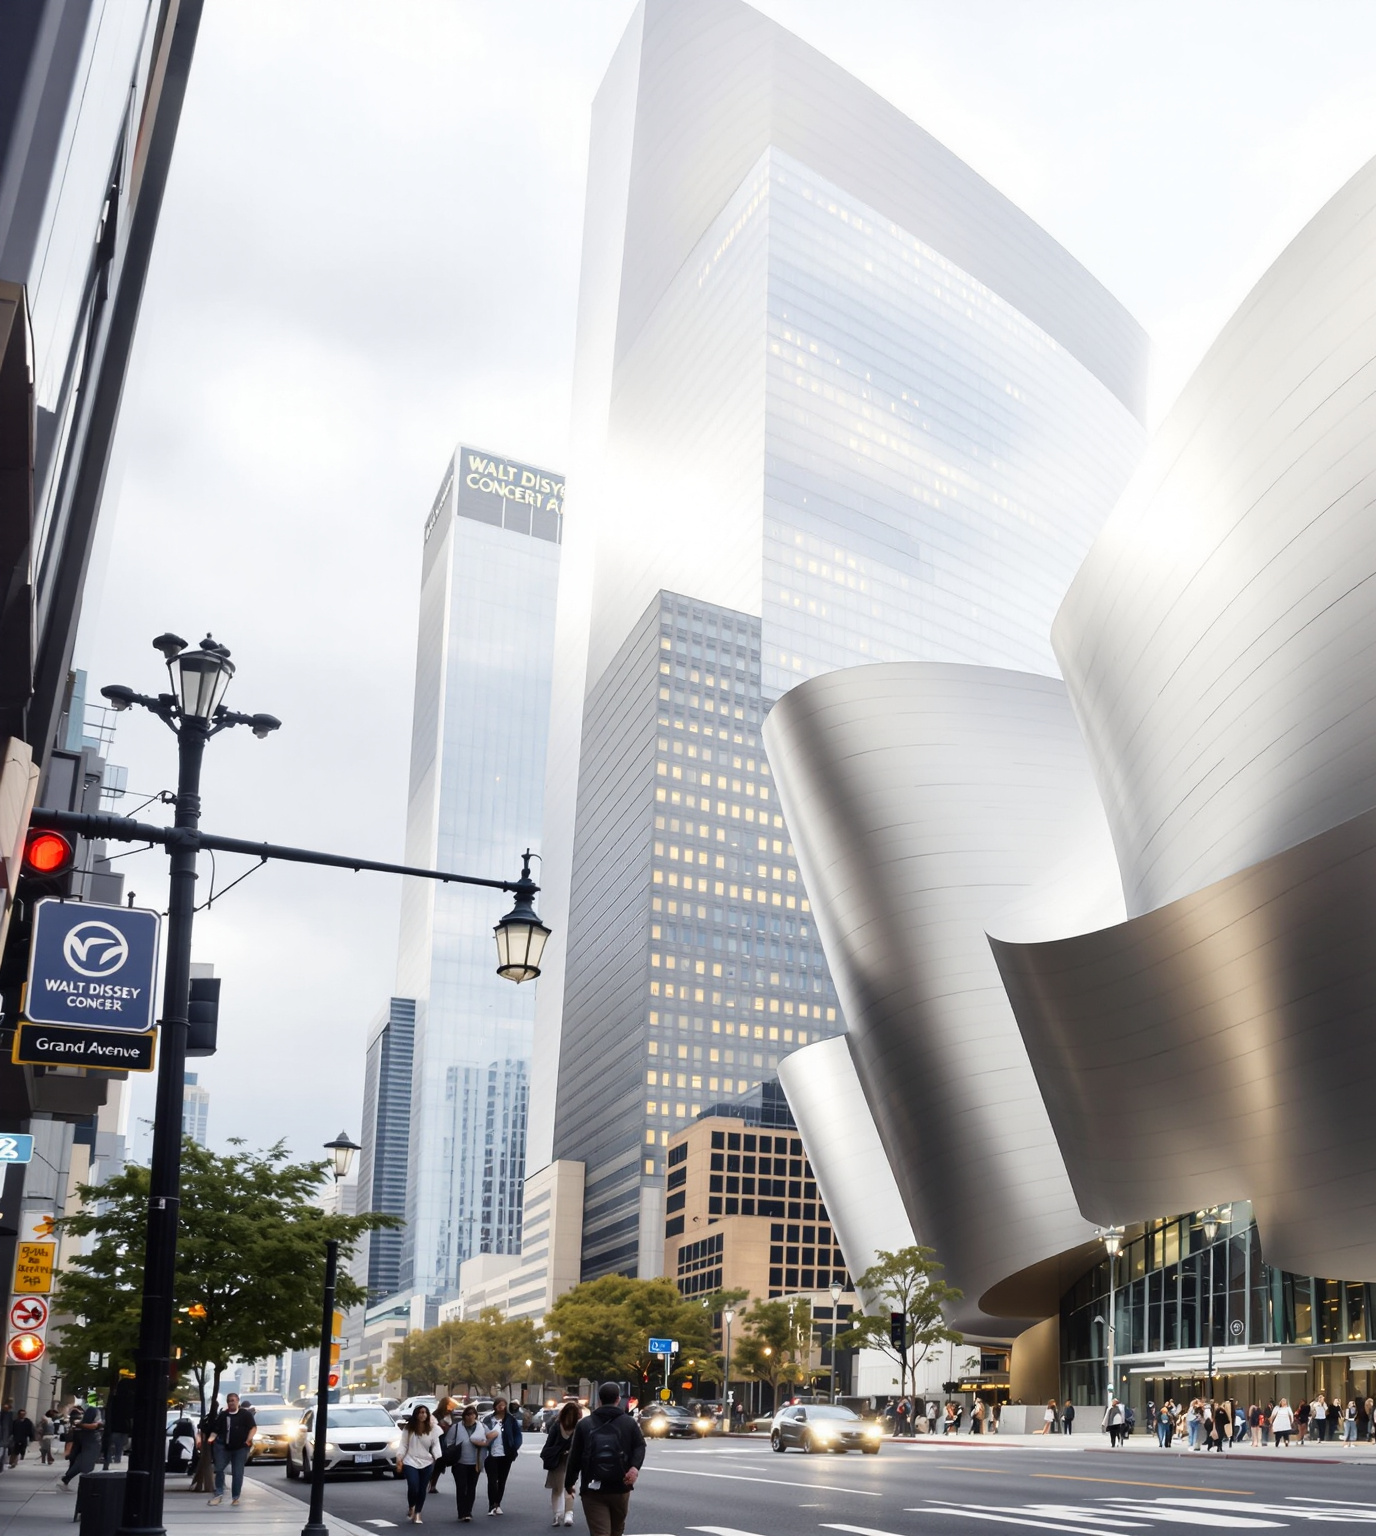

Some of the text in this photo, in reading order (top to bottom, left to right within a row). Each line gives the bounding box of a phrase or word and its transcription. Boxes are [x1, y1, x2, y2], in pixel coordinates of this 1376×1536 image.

[468, 454, 518, 482] WALT
[466, 473, 544, 508] CONCERT
[45, 978, 141, 999] WALT DISSEY
[66, 996, 123, 1011] CONCER
[36, 1037, 85, 1054] Grand
